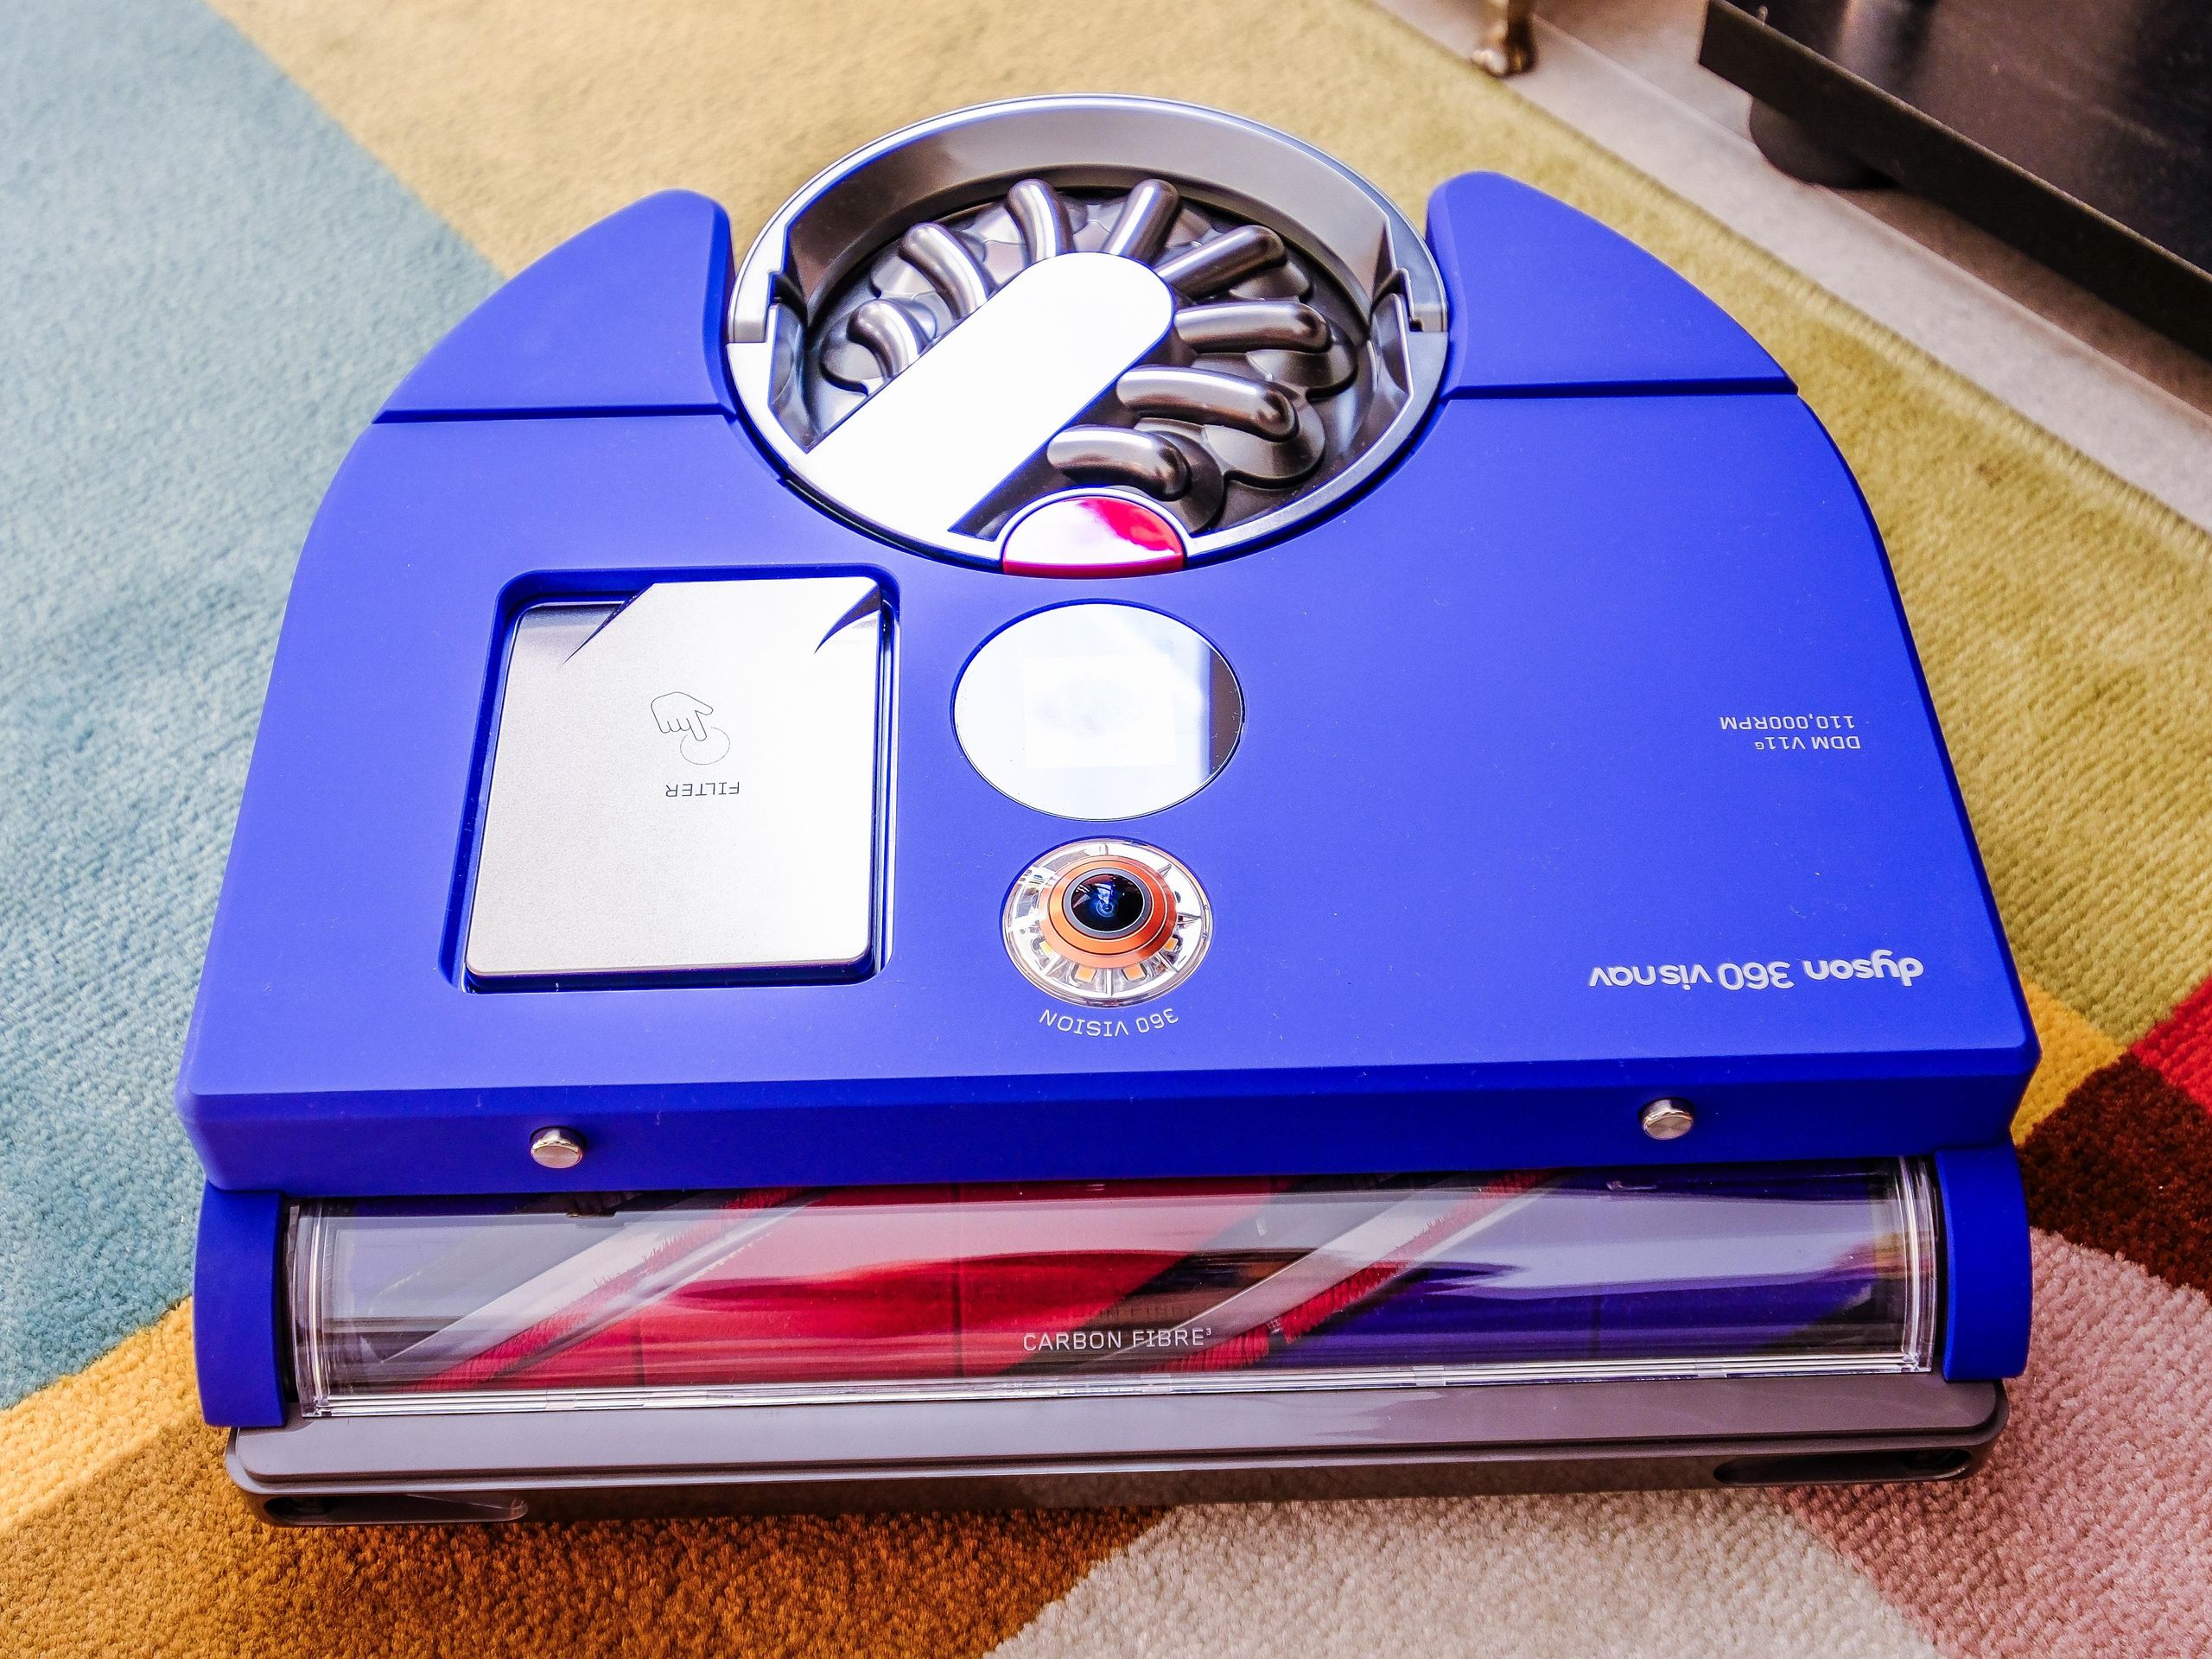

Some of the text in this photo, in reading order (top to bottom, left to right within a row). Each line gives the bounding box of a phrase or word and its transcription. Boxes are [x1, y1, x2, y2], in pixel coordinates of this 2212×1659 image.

[1719, 714, 1855, 730] 110,000RPM
[1811, 736, 1861, 750] DDM
[665, 781, 740, 797] FILTER
[1718, 962, 1796, 991] 360
[1802, 949, 1924, 987] dyson
[1039, 1008, 1179, 1037] 360 VISION
[1023, 1332, 1122, 1351] CARBON
